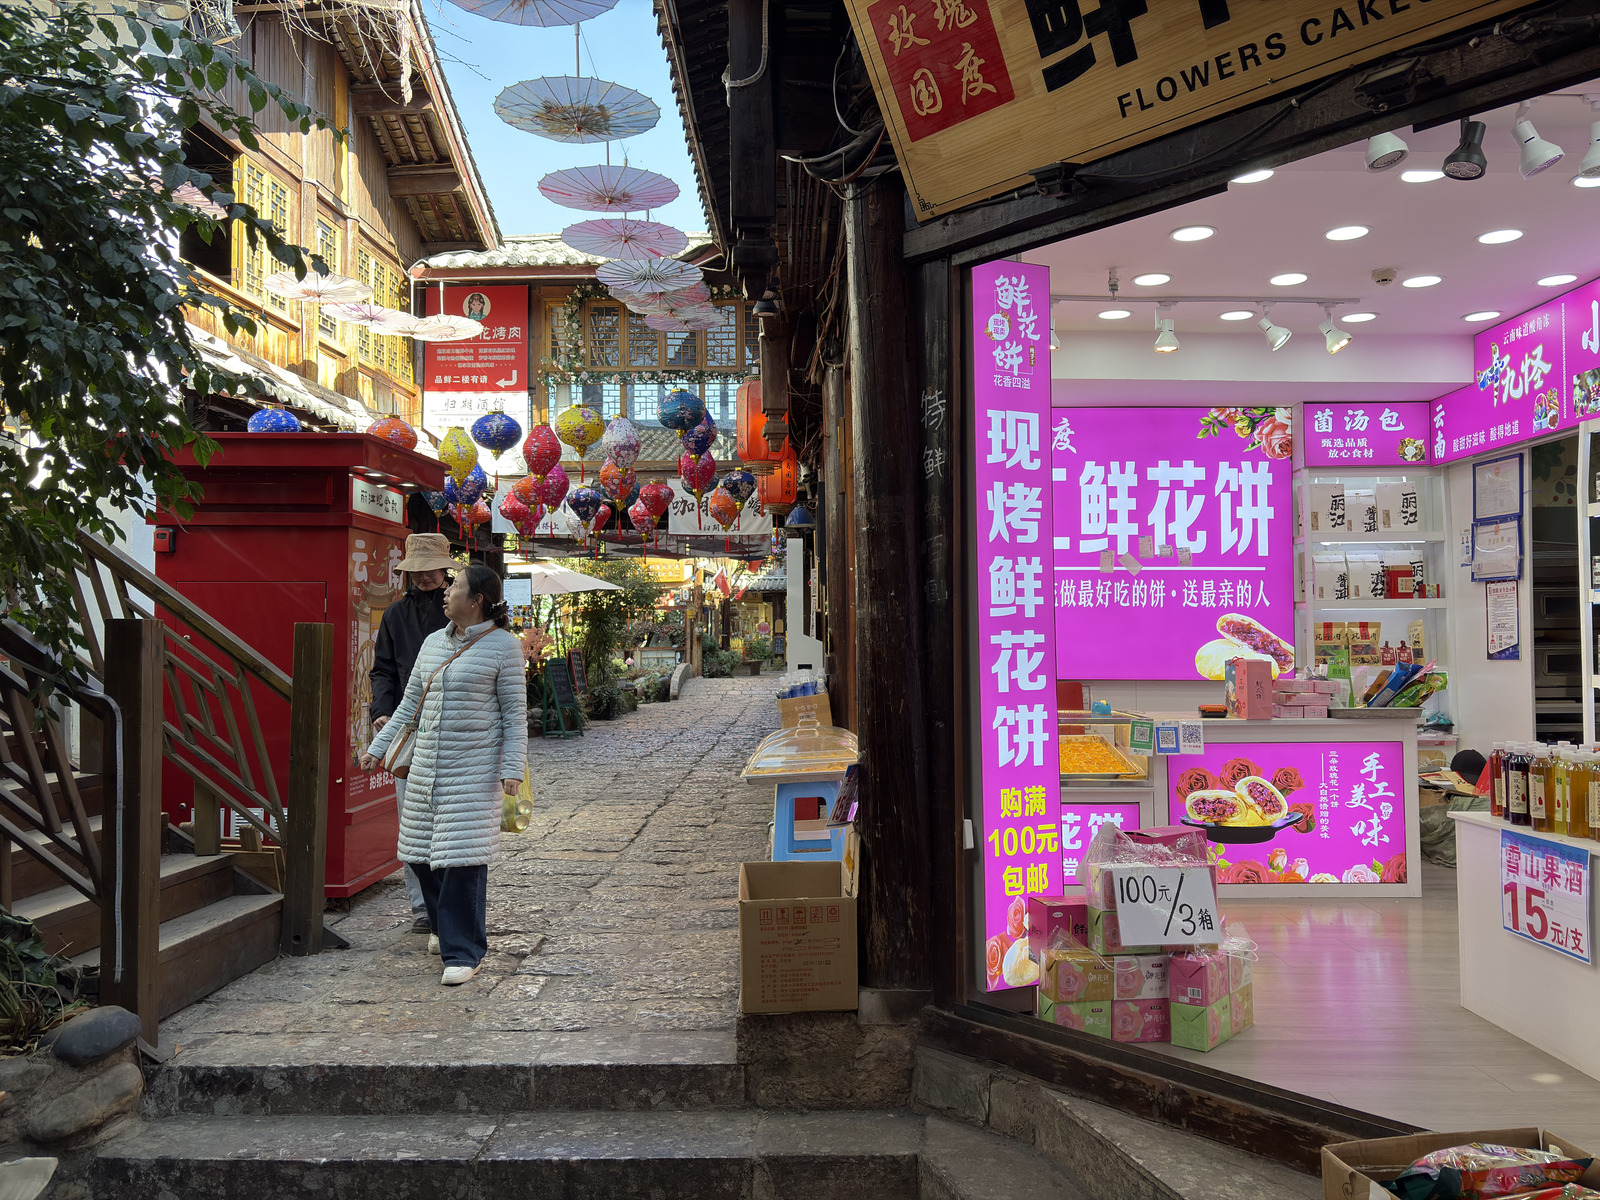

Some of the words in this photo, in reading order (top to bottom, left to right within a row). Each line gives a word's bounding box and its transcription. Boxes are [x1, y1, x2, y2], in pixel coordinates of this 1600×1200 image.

[1117, 30, 1289, 119] FLOWERS
[1299, 0, 1433, 47] CAKE
[908, 42, 998, 118] 国度
[470, 326, 521, 341] 花烤肉
[434, 375, 488, 384] 品鲜二楼有请
[993, 374, 1031, 390] 花香四溢
[920, 389, 946, 480] 特鲜
[1313, 408, 1405, 433] 菌汤包
[1433, 403, 1446, 460] 云南
[1321, 437, 1369, 448] 甄选品质
[1327, 448, 1375, 459] 放心食材
[986, 408, 1050, 768] 现烤鲜花饼
[1328, 750, 1340, 809] 三朵玫瑰花一个饼
[1000, 785, 1047, 819] 购满
[988, 823, 1059, 858] 100元
[1002, 863, 1049, 897] 包邮
[1505, 844, 1584, 896] 雪山果酒
